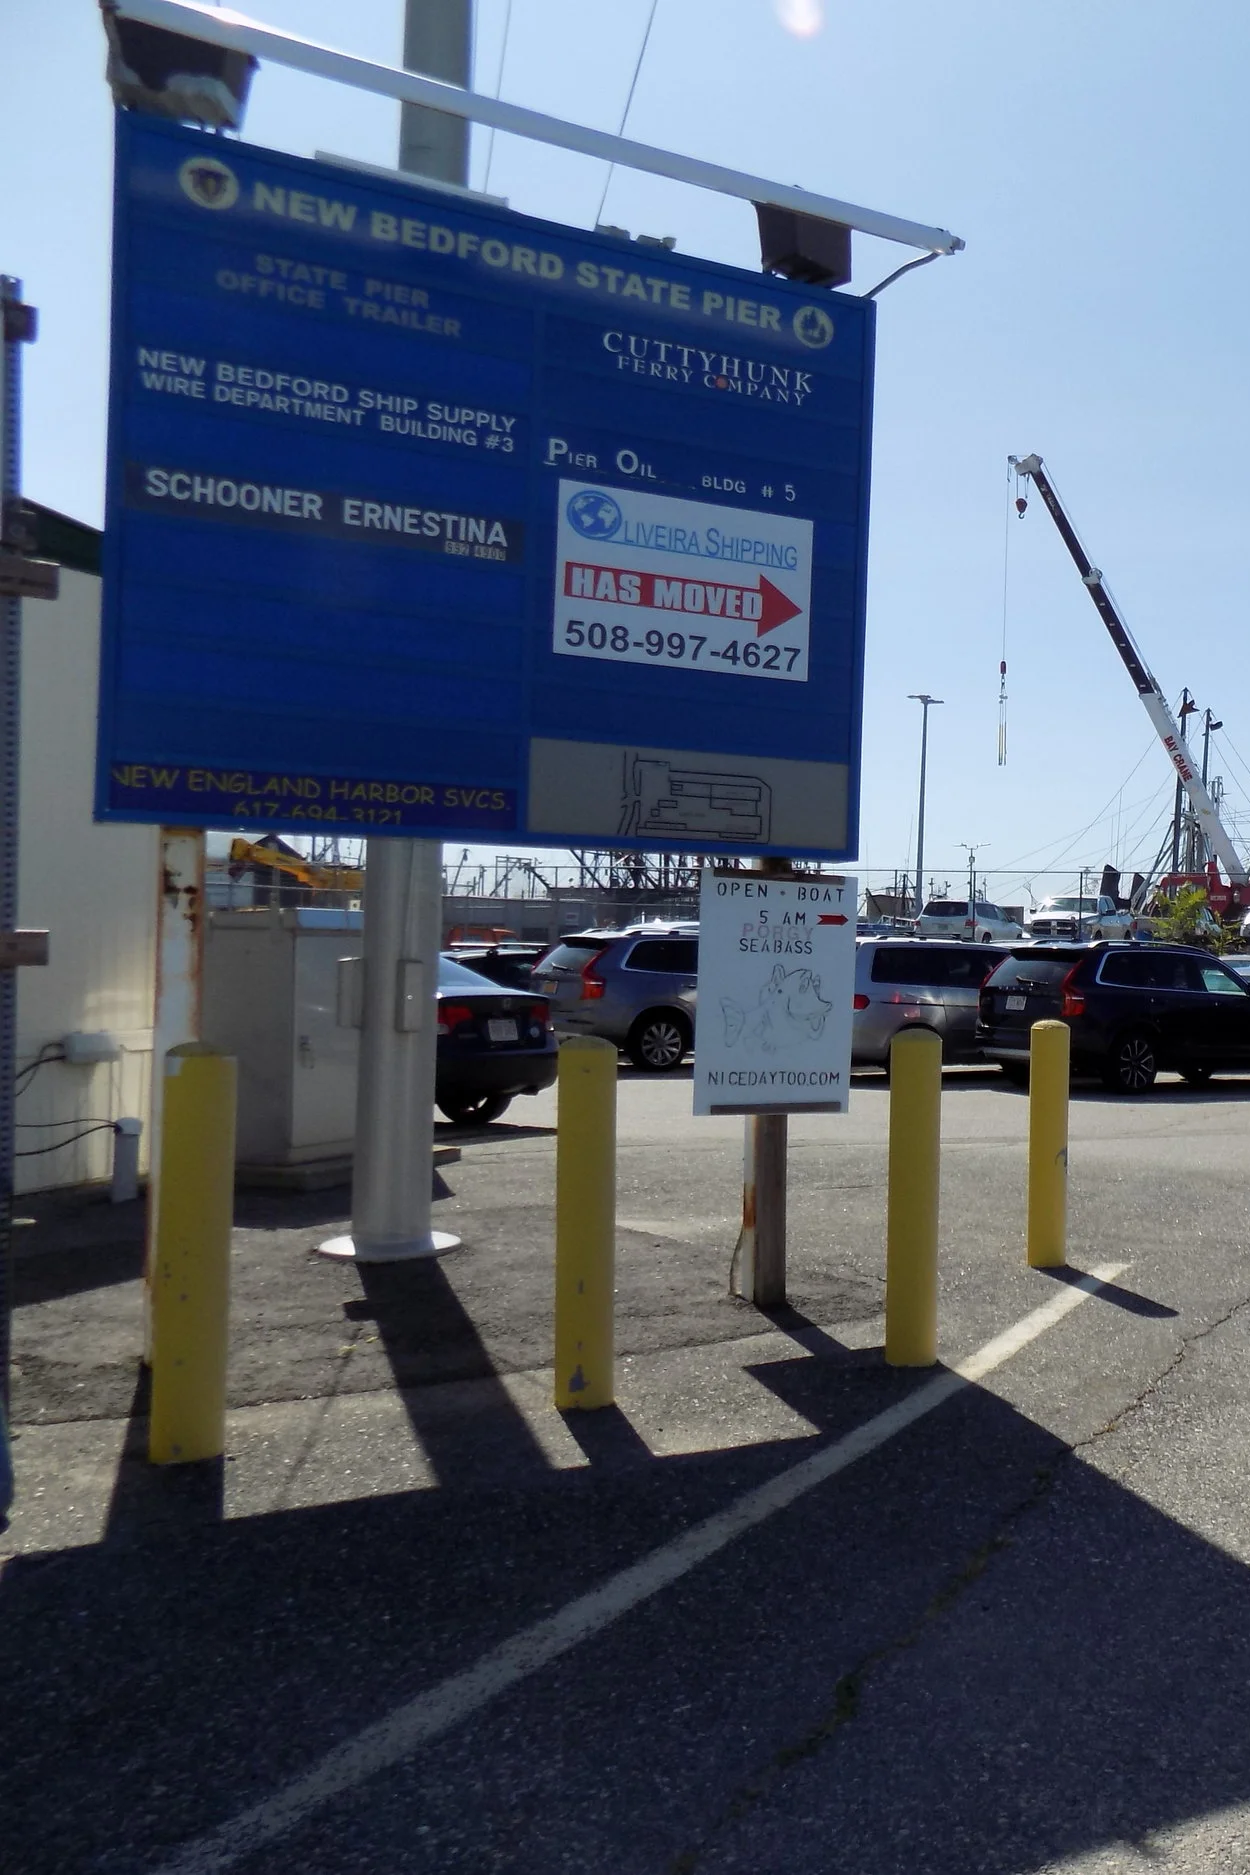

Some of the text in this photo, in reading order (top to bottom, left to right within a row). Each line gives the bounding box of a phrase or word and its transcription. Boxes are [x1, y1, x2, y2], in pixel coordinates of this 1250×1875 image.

[253, 181, 782, 332] NEW BEDFORD STATE PIER
[216, 269, 462, 338] OFFICE TRAILER
[255, 253, 430, 309] STATE PIER
[602, 331, 813, 394] CUTTYHUNK
[617, 356, 692, 384] FERRY
[137, 346, 516, 434] NEW BEDFORD SHIP SUPPLY
[142, 371, 515, 453] WIRE DEPARTMENT BUILDING #3
[145, 469, 509, 548] SCHOONER ERNESTINA
[702, 475, 746, 494] BLDG
[785, 484, 796, 502] 5
[705, 527, 798, 569] SHIPPING
[571, 566, 763, 621] HAS MOVED
[565, 619, 801, 672] 508-997-4627
[1164, 735, 1193, 783] BAY CRANE
[111, 764, 181, 790] NEW
[187, 768, 320, 800] ENGLAND
[330, 780, 435, 806] HARBOR
[717, 882, 845, 903] OPEN BOAT
[743, 922, 814, 941] PORGY
[759, 910, 806, 926] 5 AM
[739, 937, 813, 955] SEABASS
[708, 1070, 840, 1087] NICEDAYTOO.COM
